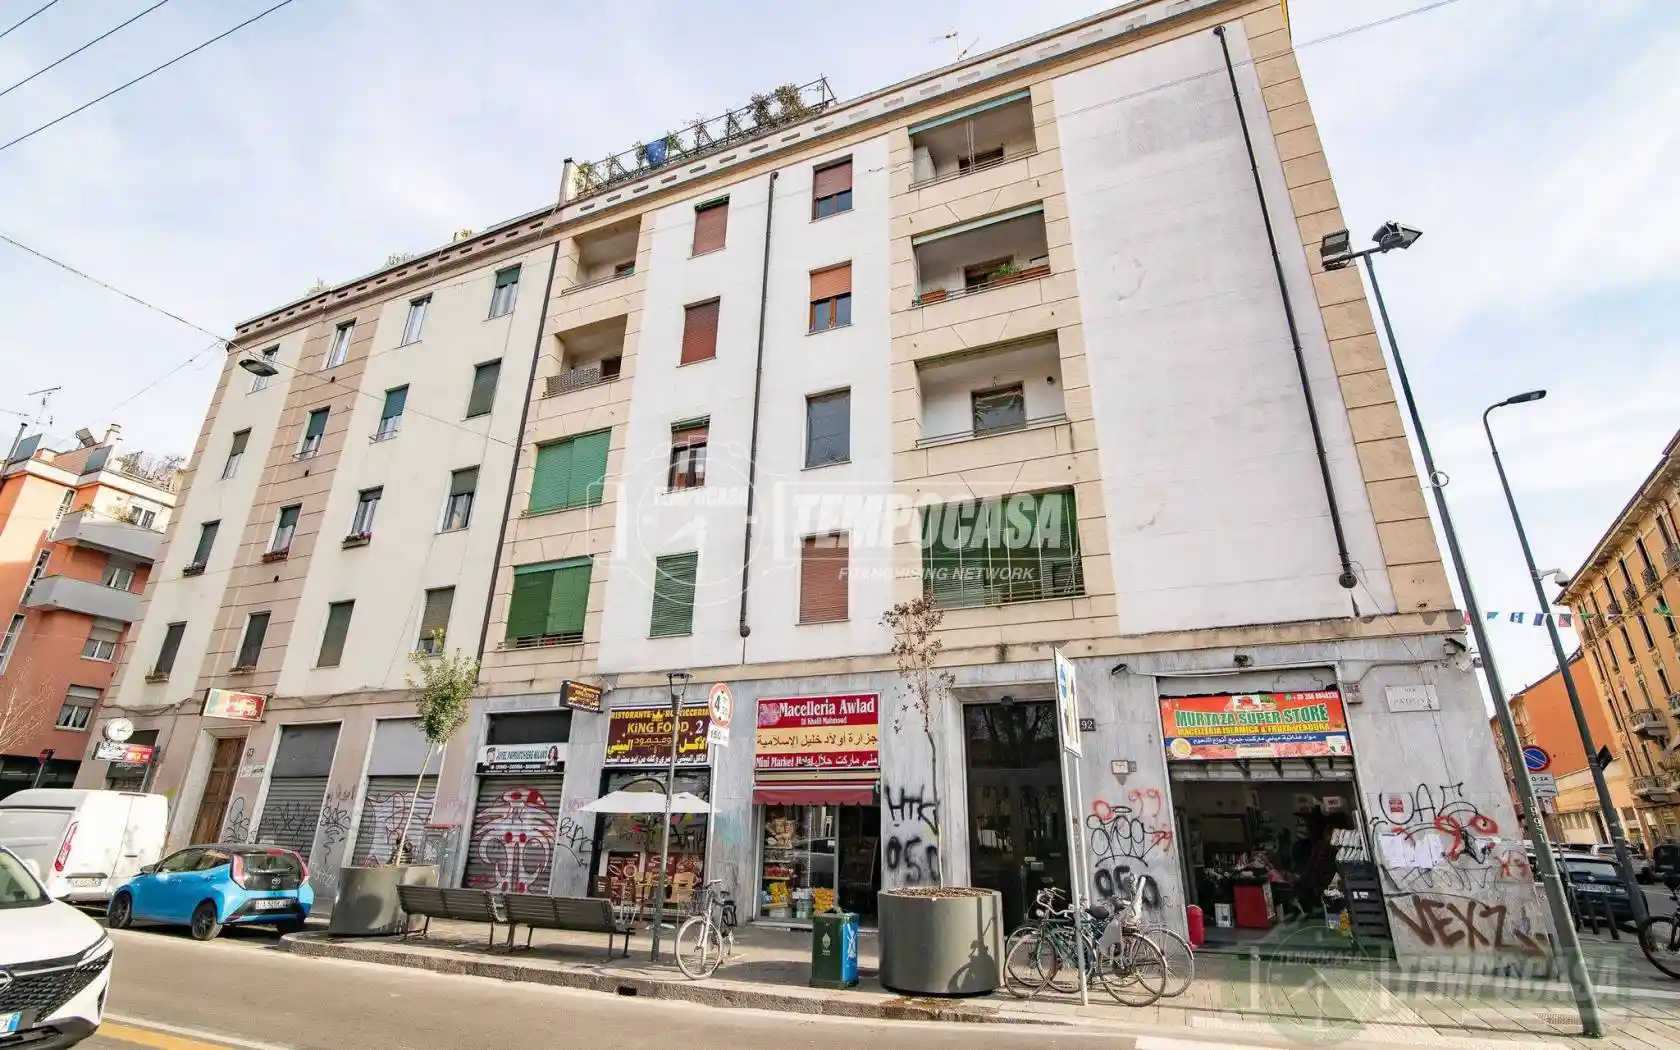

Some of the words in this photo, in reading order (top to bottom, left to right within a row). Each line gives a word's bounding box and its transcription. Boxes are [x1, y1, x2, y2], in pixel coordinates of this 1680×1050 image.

[779, 699, 836, 717] Macelleria
[839, 698, 875, 714] Awlad
[611, 710, 652, 720] RISTORANTE
[1175, 710, 1237, 727] MURTAZA
[1238, 709, 1281, 726] SUPER
[1283, 703, 1330, 723] STORE
[695, 720, 704, 734] 2
[1080, 720, 1094, 729] 92
[1223, 725, 1259, 735] ISLAMICA
